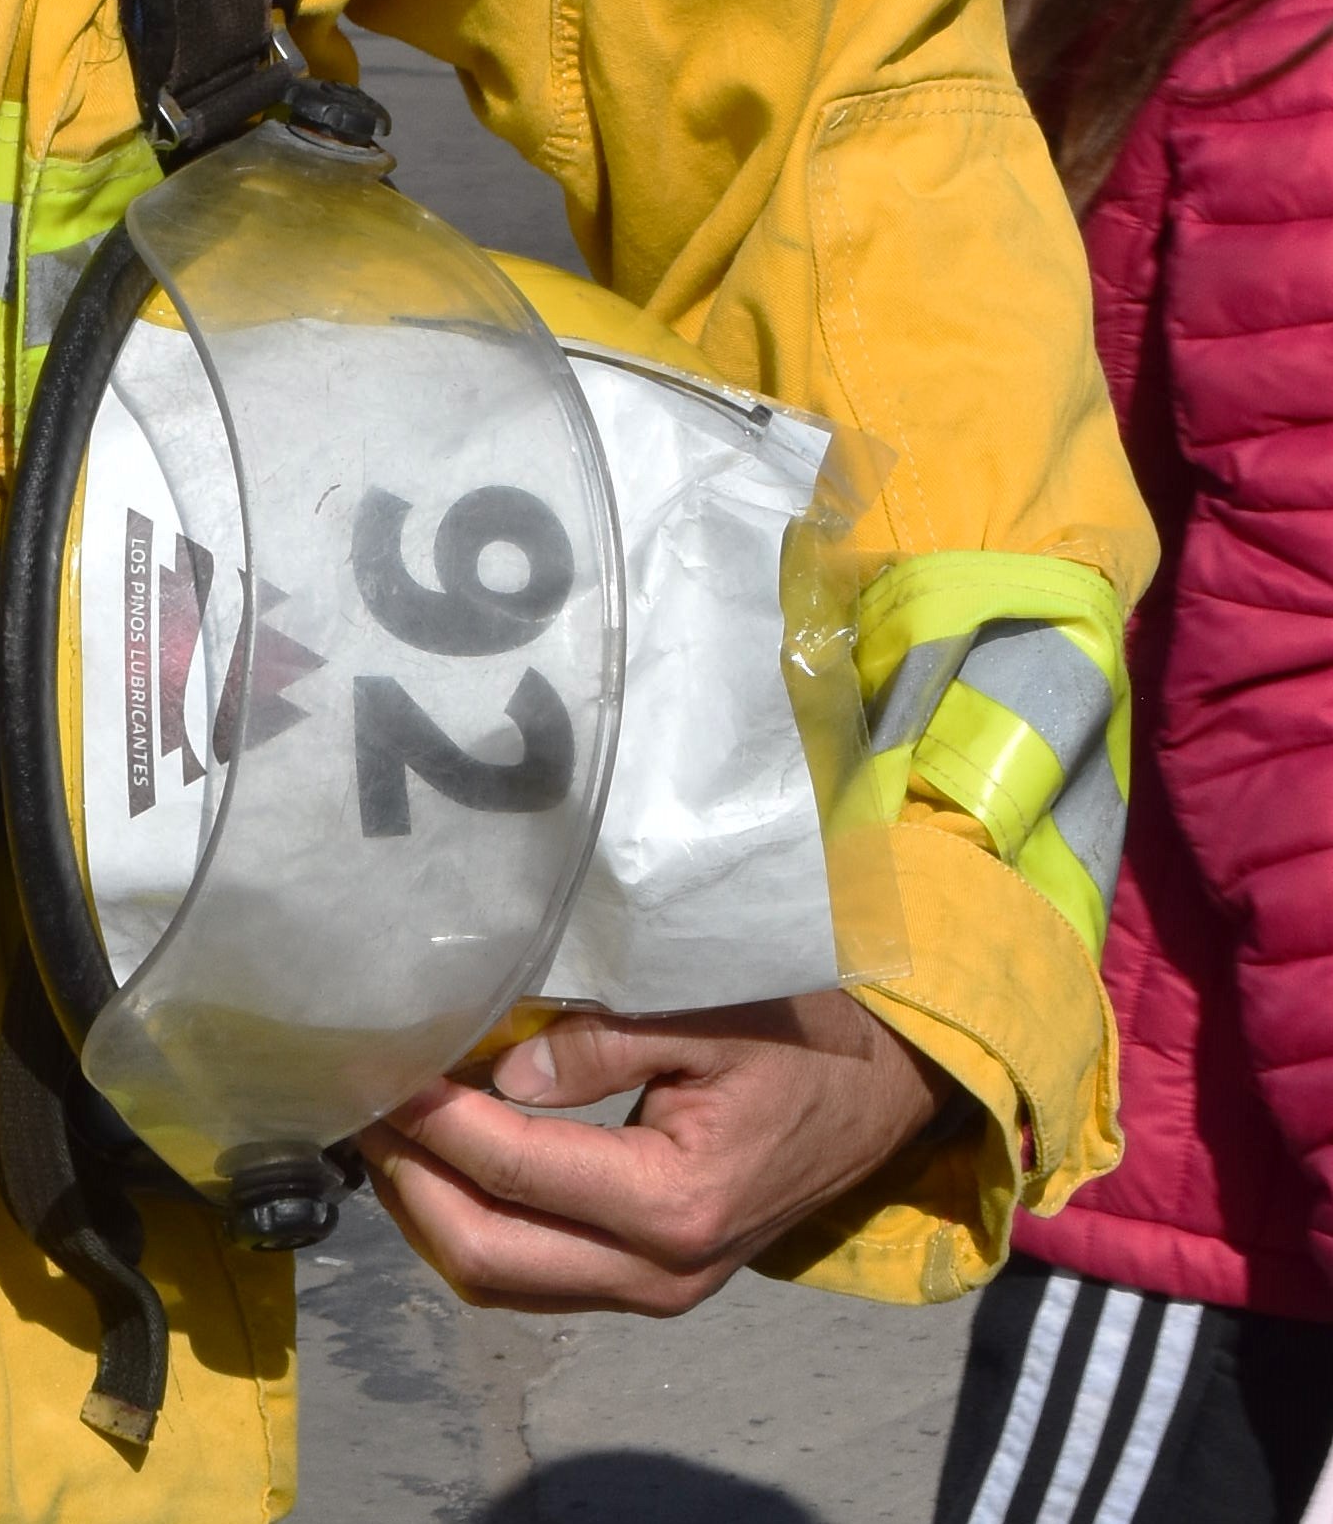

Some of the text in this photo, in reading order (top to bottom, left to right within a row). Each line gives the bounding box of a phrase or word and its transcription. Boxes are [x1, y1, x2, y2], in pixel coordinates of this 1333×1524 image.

[130, 537, 148, 787] LOS PINOS LUBRICANTES
[352, 484, 575, 838] 92
